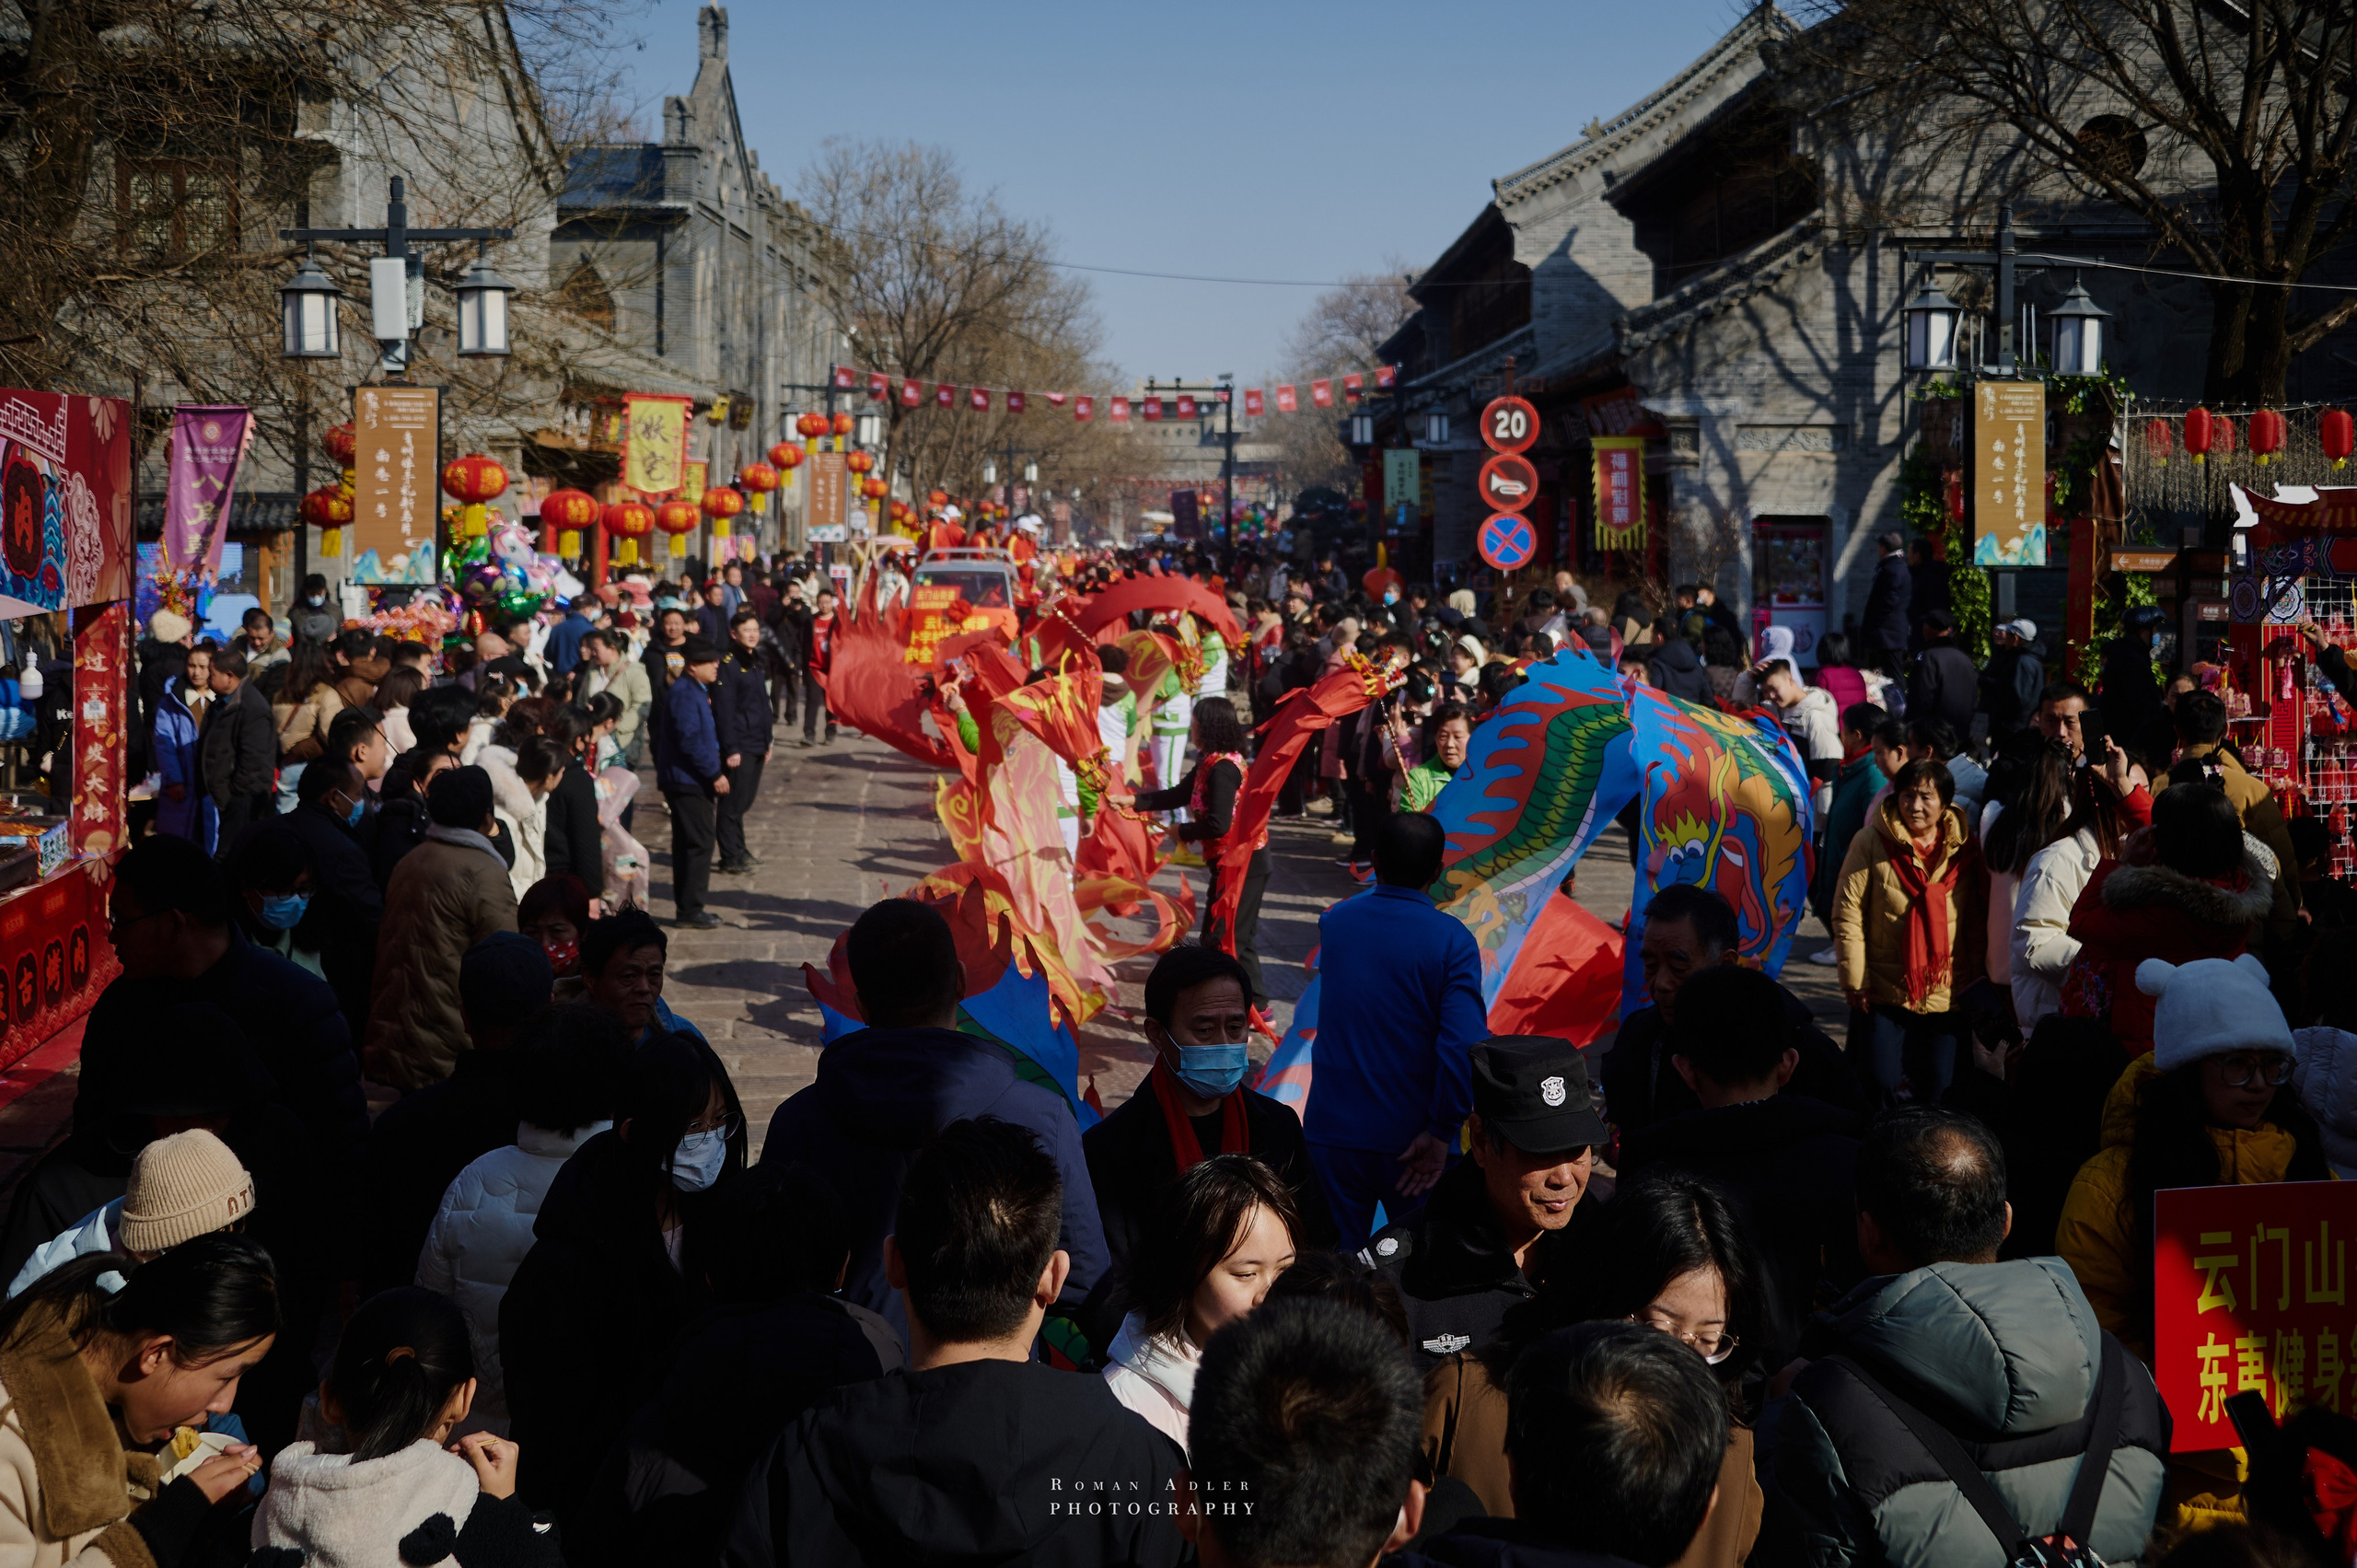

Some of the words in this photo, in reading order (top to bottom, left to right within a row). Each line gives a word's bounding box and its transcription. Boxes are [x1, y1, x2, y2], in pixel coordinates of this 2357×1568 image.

[1495, 410, 1527, 438] 20
[1610, 453, 1630, 524] 福利彩票
[923, 615, 990, 631] 云门街道
[2194, 1220, 2357, 1315] 云门山
[2197, 1326, 2357, 1424] 东夷健身
